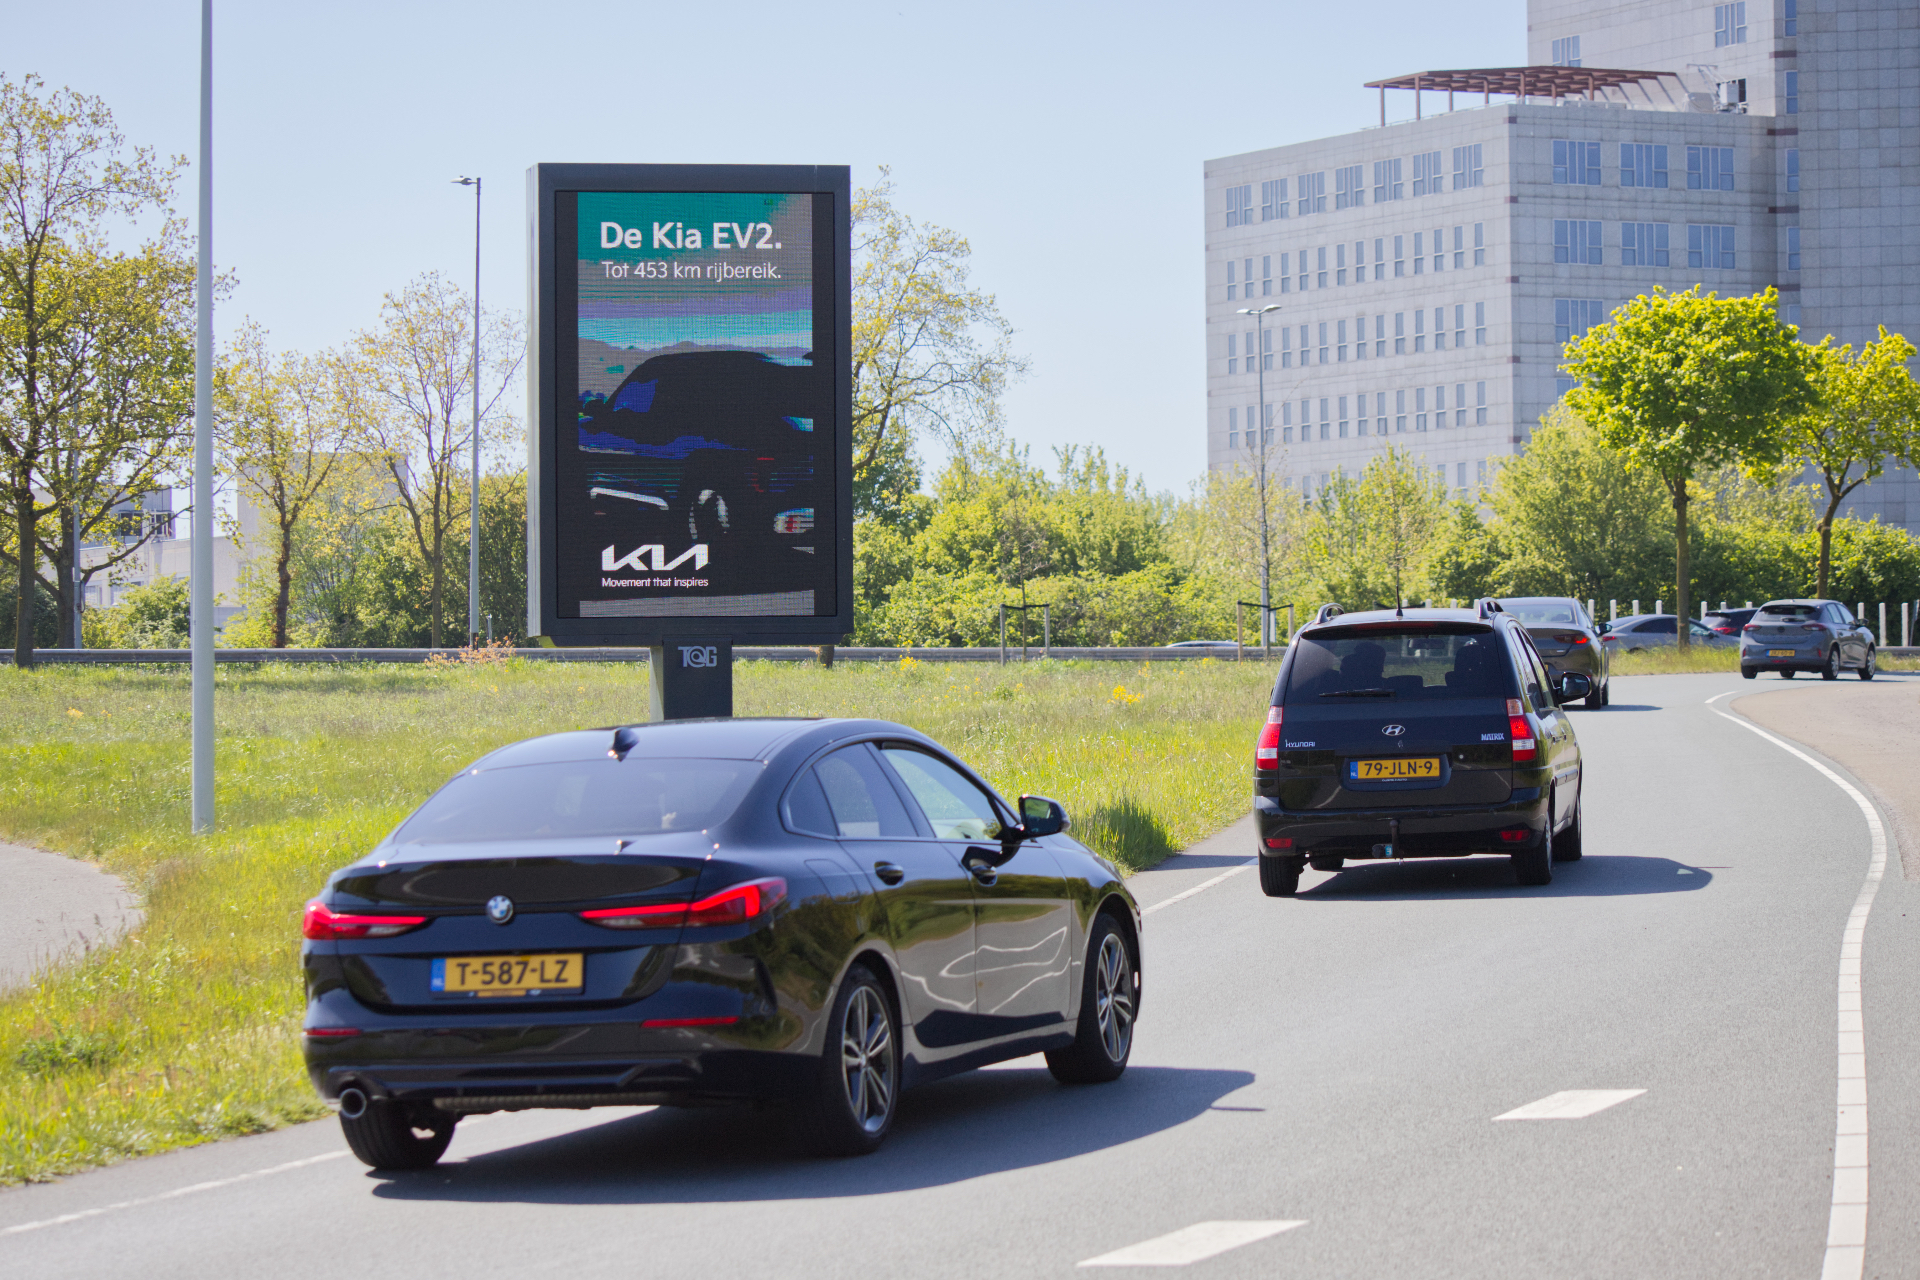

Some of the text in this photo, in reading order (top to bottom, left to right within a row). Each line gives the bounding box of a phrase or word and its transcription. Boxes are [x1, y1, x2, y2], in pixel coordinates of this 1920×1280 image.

[600, 221, 782, 249] De Kia EV2.
[601, 261, 782, 283] Tot 453 km rijbereik.
[601, 544, 709, 571] KIA
[601, 577, 709, 589] Movement that inspires
[1284, 738, 1316, 748] HYUNDAI
[1481, 732, 1505, 741] MATRIX
[1364, 761, 1433, 776] 79-JLN-9
[456, 959, 569, 986] T-587-LZ
